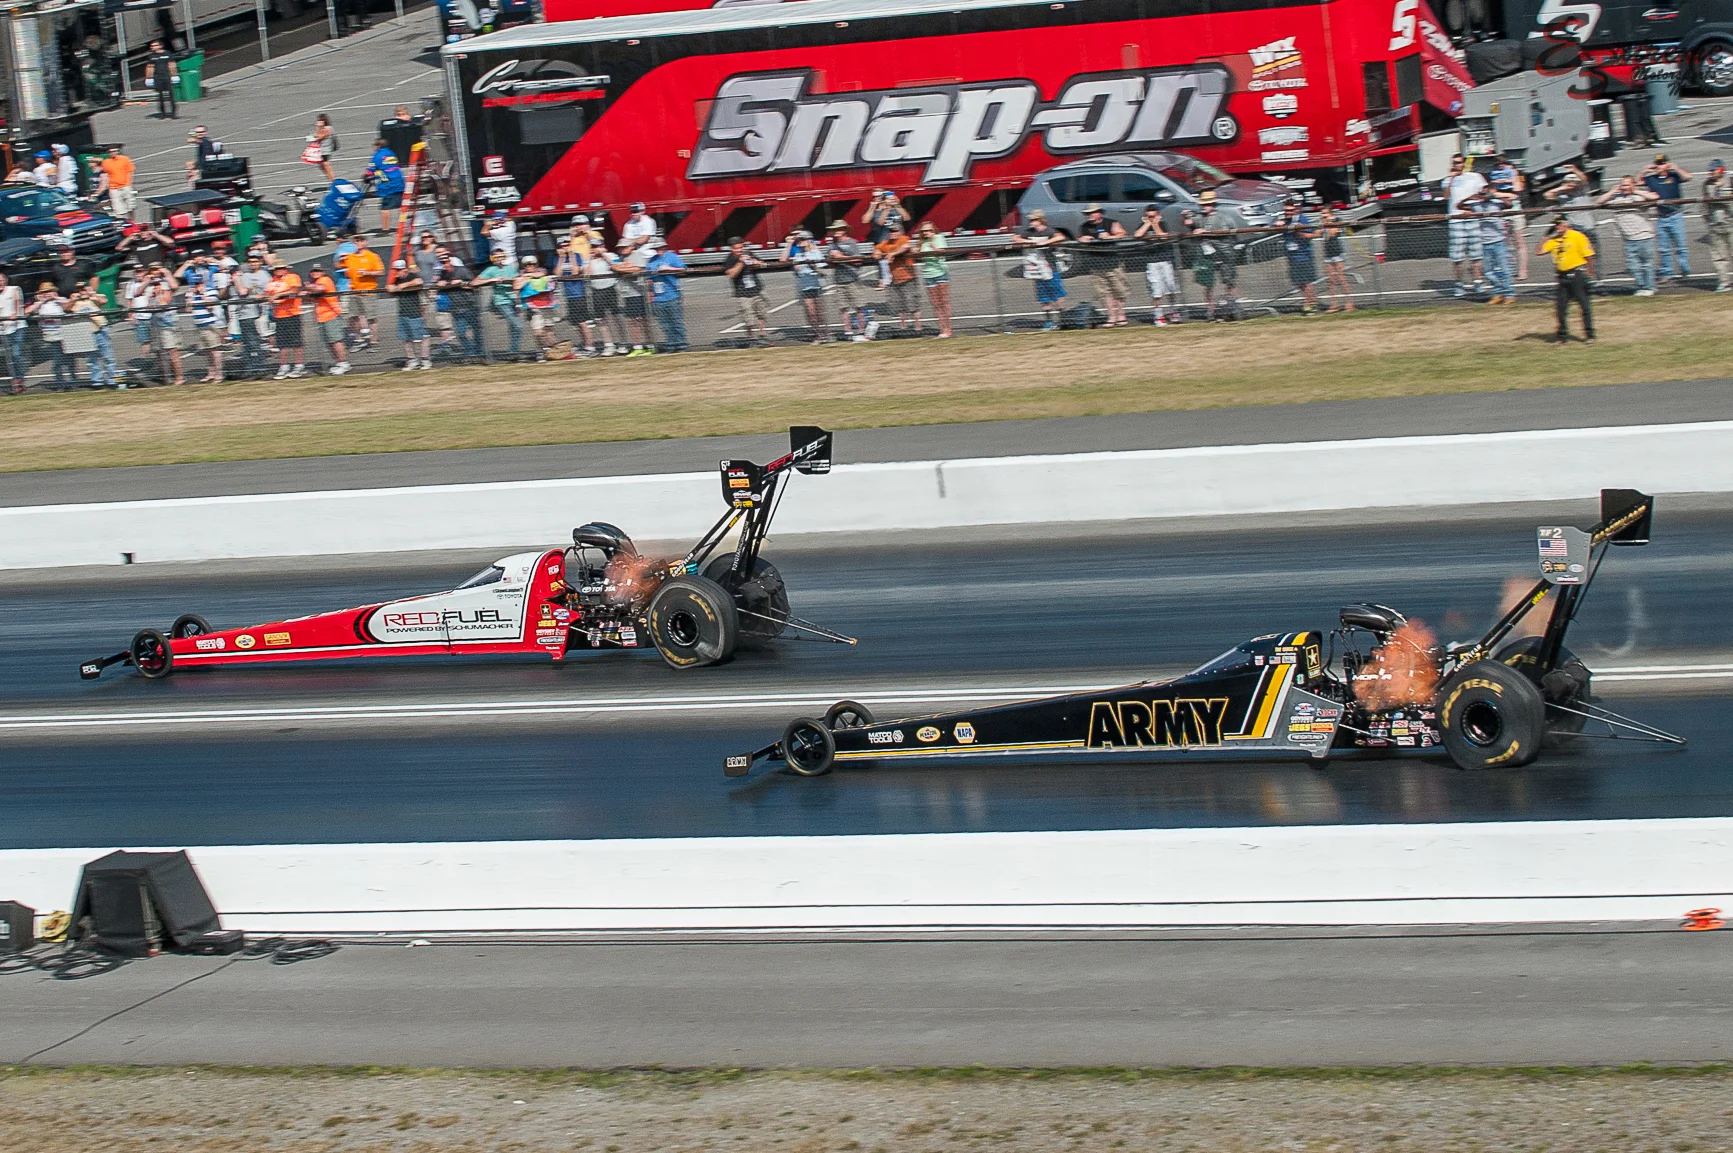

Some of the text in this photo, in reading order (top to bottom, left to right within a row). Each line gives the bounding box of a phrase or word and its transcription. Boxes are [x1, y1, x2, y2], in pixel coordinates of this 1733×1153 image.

[688, 68, 1231, 182] Snap-on
[768, 452, 795, 472] RED
[792, 439, 823, 461] FUEL
[1552, 528, 1562, 538] 2
[449, 623, 514, 632] SCHUMACHER
[956, 730, 974, 739] NAPA
[1088, 698, 1229, 751] ARMY
